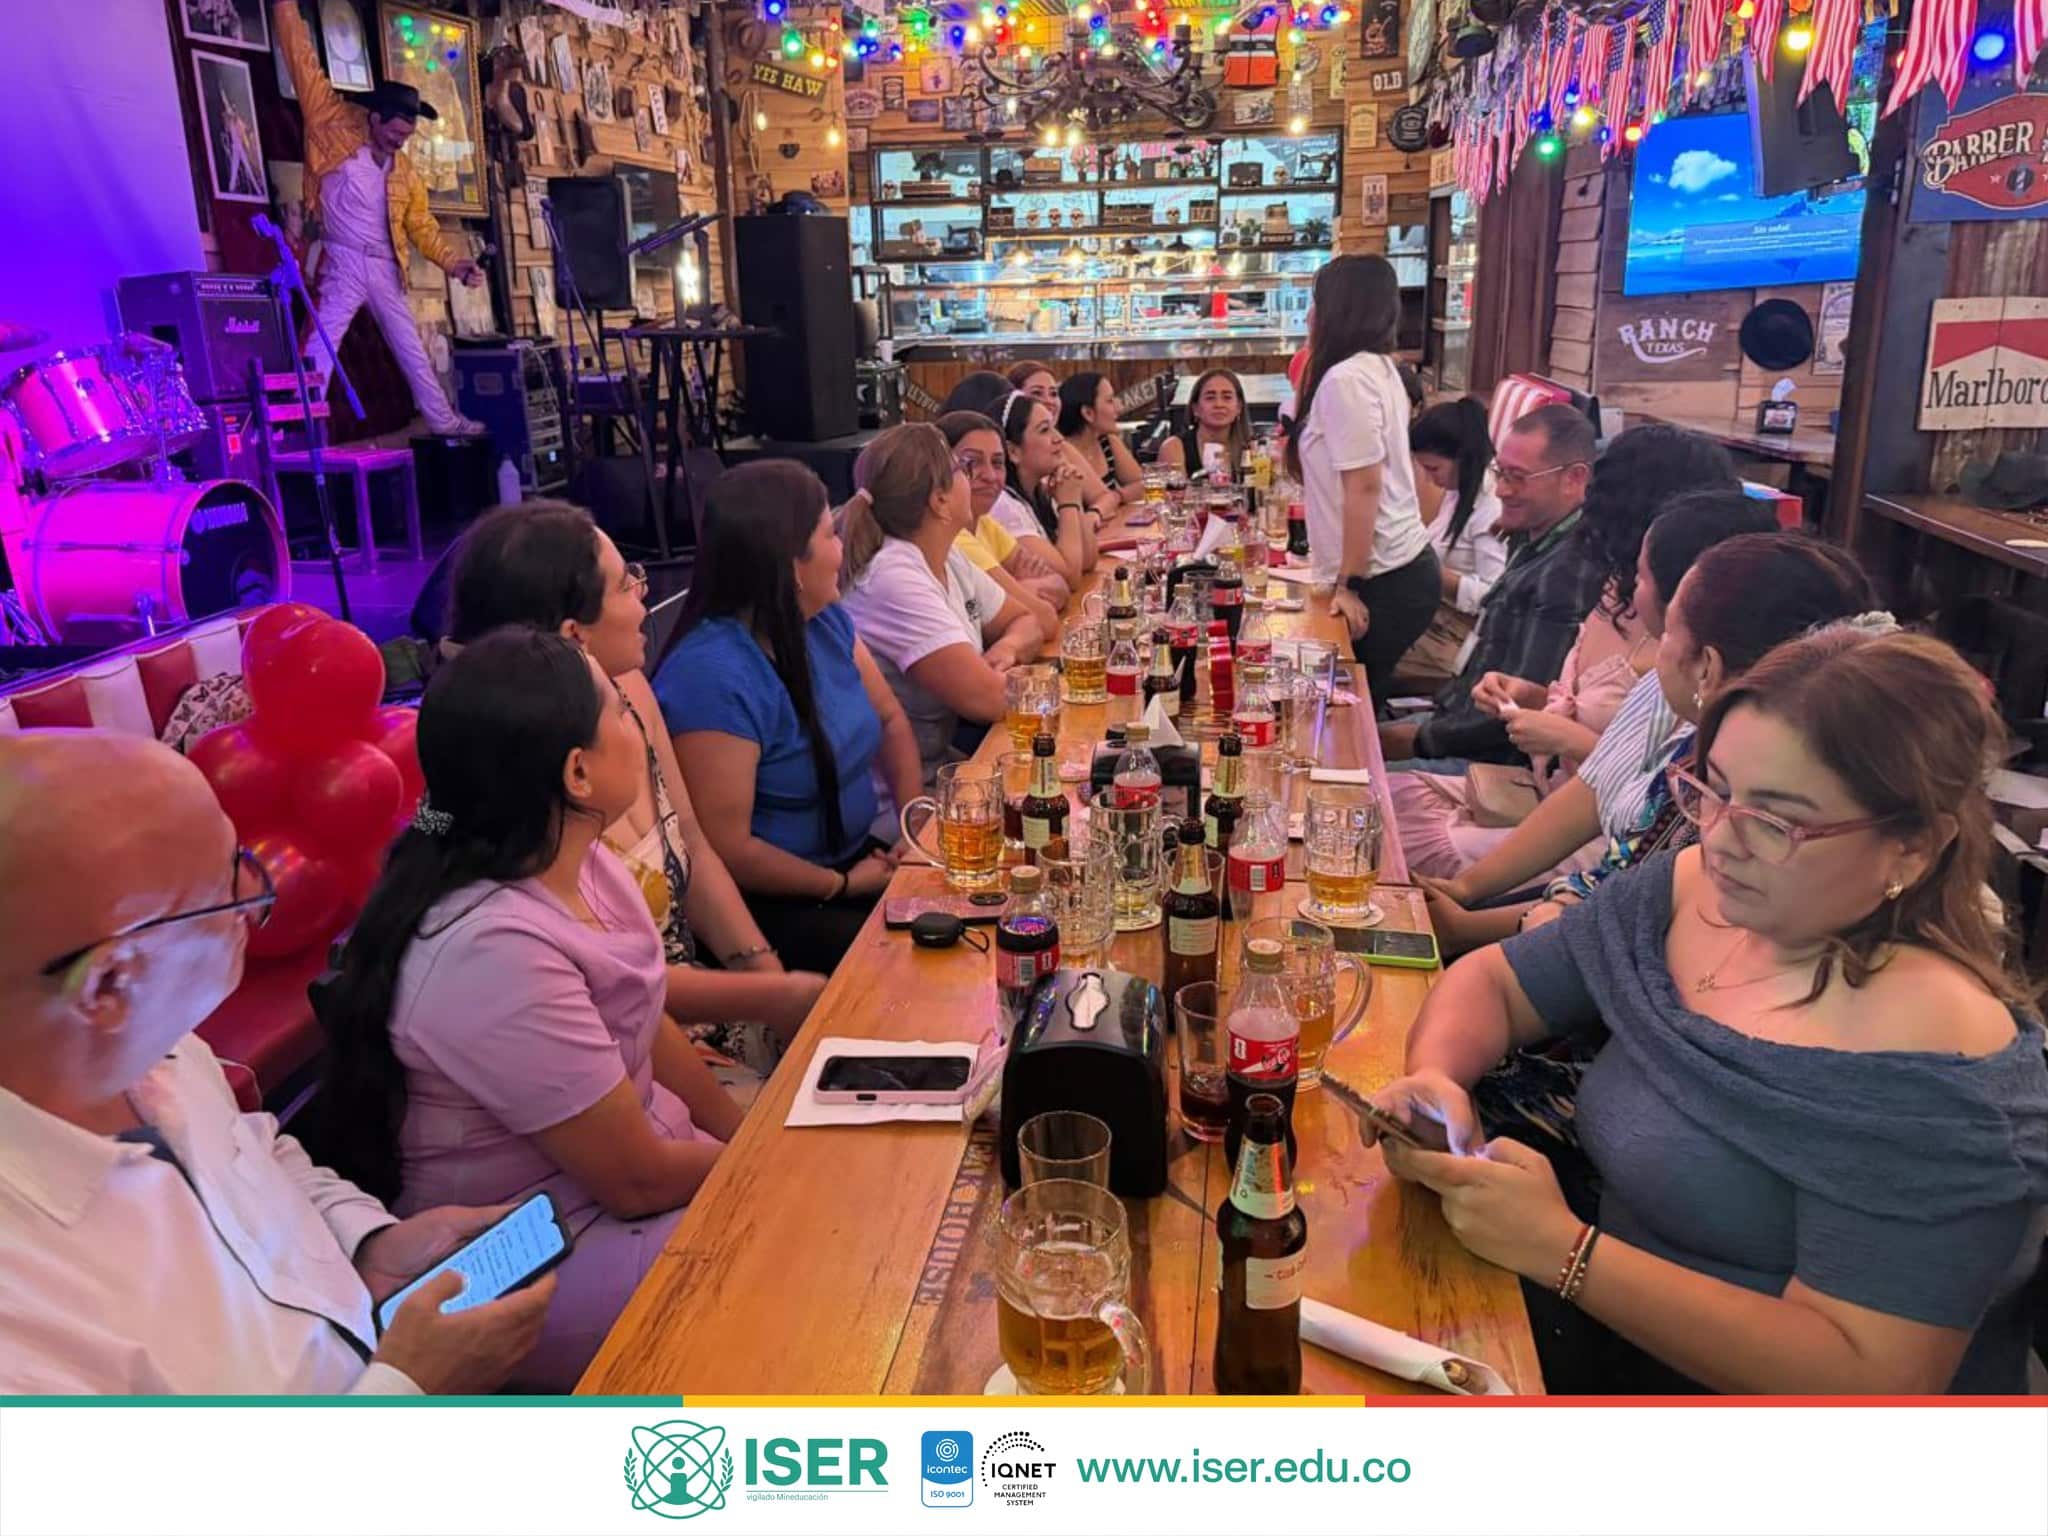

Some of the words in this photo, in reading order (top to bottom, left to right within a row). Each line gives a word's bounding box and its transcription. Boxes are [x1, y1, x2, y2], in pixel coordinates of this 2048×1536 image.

[754, 63, 779, 86] YEE
[781, 70, 824, 97] HAW
[1922, 120, 2034, 187] BARBER
[1618, 318, 1718, 347] RANCH
[1646, 341, 1685, 354] TEXAS
